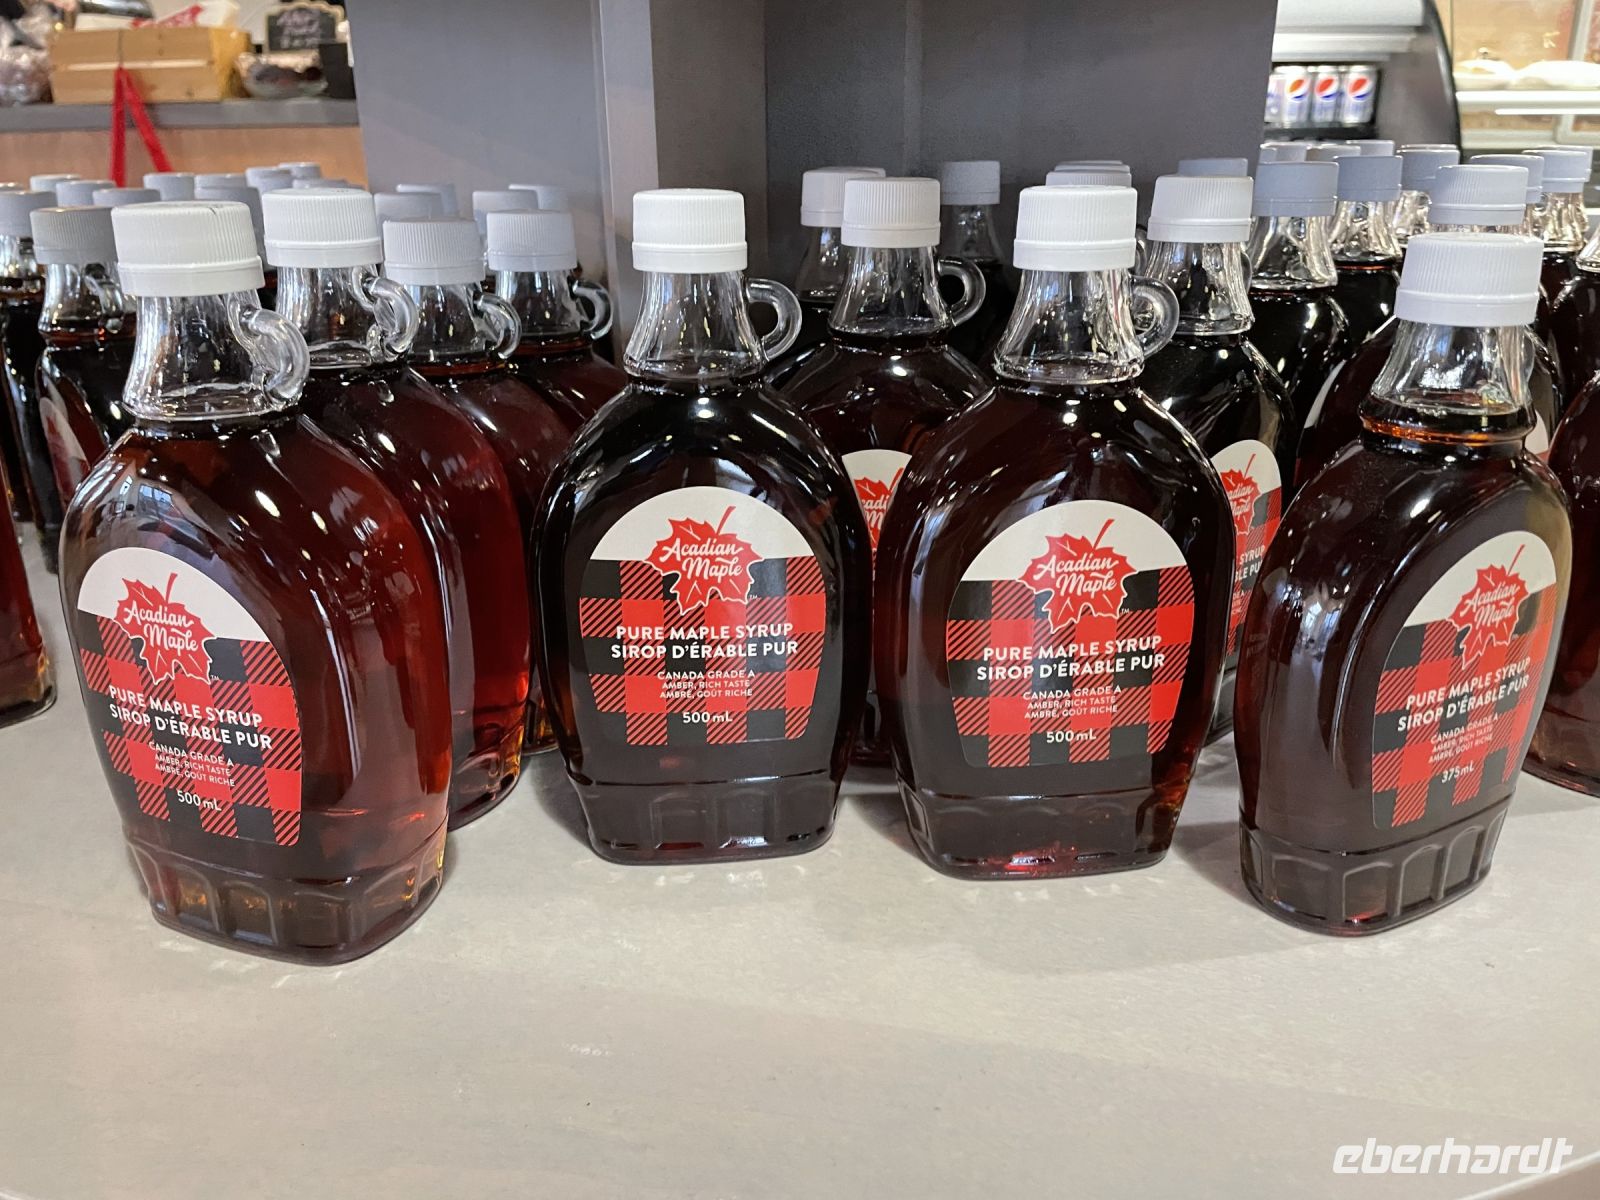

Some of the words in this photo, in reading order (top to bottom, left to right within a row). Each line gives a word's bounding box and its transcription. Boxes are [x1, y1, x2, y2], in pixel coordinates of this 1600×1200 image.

[659, 538, 743, 562] Acadian
[682, 556, 743, 583] Maple
[1033, 553, 1119, 580] Acadian
[1056, 571, 1117, 599] Maple
[1460, 581, 1520, 617] Acadian
[123, 601, 194, 626] Acadian
[1474, 597, 1514, 629] Maple
[144, 624, 198, 656] Maple
[616, 626, 664, 640] PURE
[670, 626, 734, 640] MAPLE
[736, 623, 793, 639] SYRUP
[611, 645, 667, 659] SIROP
[672, 641, 757, 659] D'ÉRABLE
[763, 641, 799, 656] PUR
[983, 647, 1033, 661] PURE
[1038, 642, 1100, 659] MAPLE
[1105, 635, 1162, 655] SYRUP
[657, 671, 705, 680] CANADA
[707, 669, 746, 679] GRADE
[748, 669, 755, 678] A
[977, 665, 1034, 681] SIROP
[1039, 659, 1125, 678] D'ÉRABLE
[1131, 654, 1165, 670] PUR
[662, 681, 697, 690] AMBER,
[724, 680, 750, 688] TASTE
[725, 688, 753, 697] RICHE
[1023, 689, 1071, 700] CANADA
[1073, 686, 1112, 697] GRADE
[1114, 684, 1121, 694] A
[1406, 687, 1446, 710] PURE
[1449, 672, 1492, 699] MAPLE
[1494, 657, 1531, 682] SYRUP
[109, 685, 146, 707] PURE
[150, 696, 202, 719] MAPLE
[205, 706, 263, 728] SYRUP
[1027, 700, 1062, 709] AMBER,
[1065, 698, 1087, 707] RICH
[1090, 696, 1116, 705] TASTE
[1090, 705, 1118, 714] RICHE
[1397, 706, 1444, 732] SIROP
[1507, 674, 1530, 696] PUR
[109, 703, 151, 726] SIROP
[155, 716, 232, 743] D'ÉRABLE
[236, 731, 273, 749] PUR
[1431, 726, 1465, 745] CANADA
[149, 741, 188, 758] CANADA
[190, 751, 226, 765] GRADE
[227, 758, 234, 767] A
[185, 761, 204, 771] RICH
[206, 765, 231, 776] TASTE
[209, 775, 235, 787] RICHE
